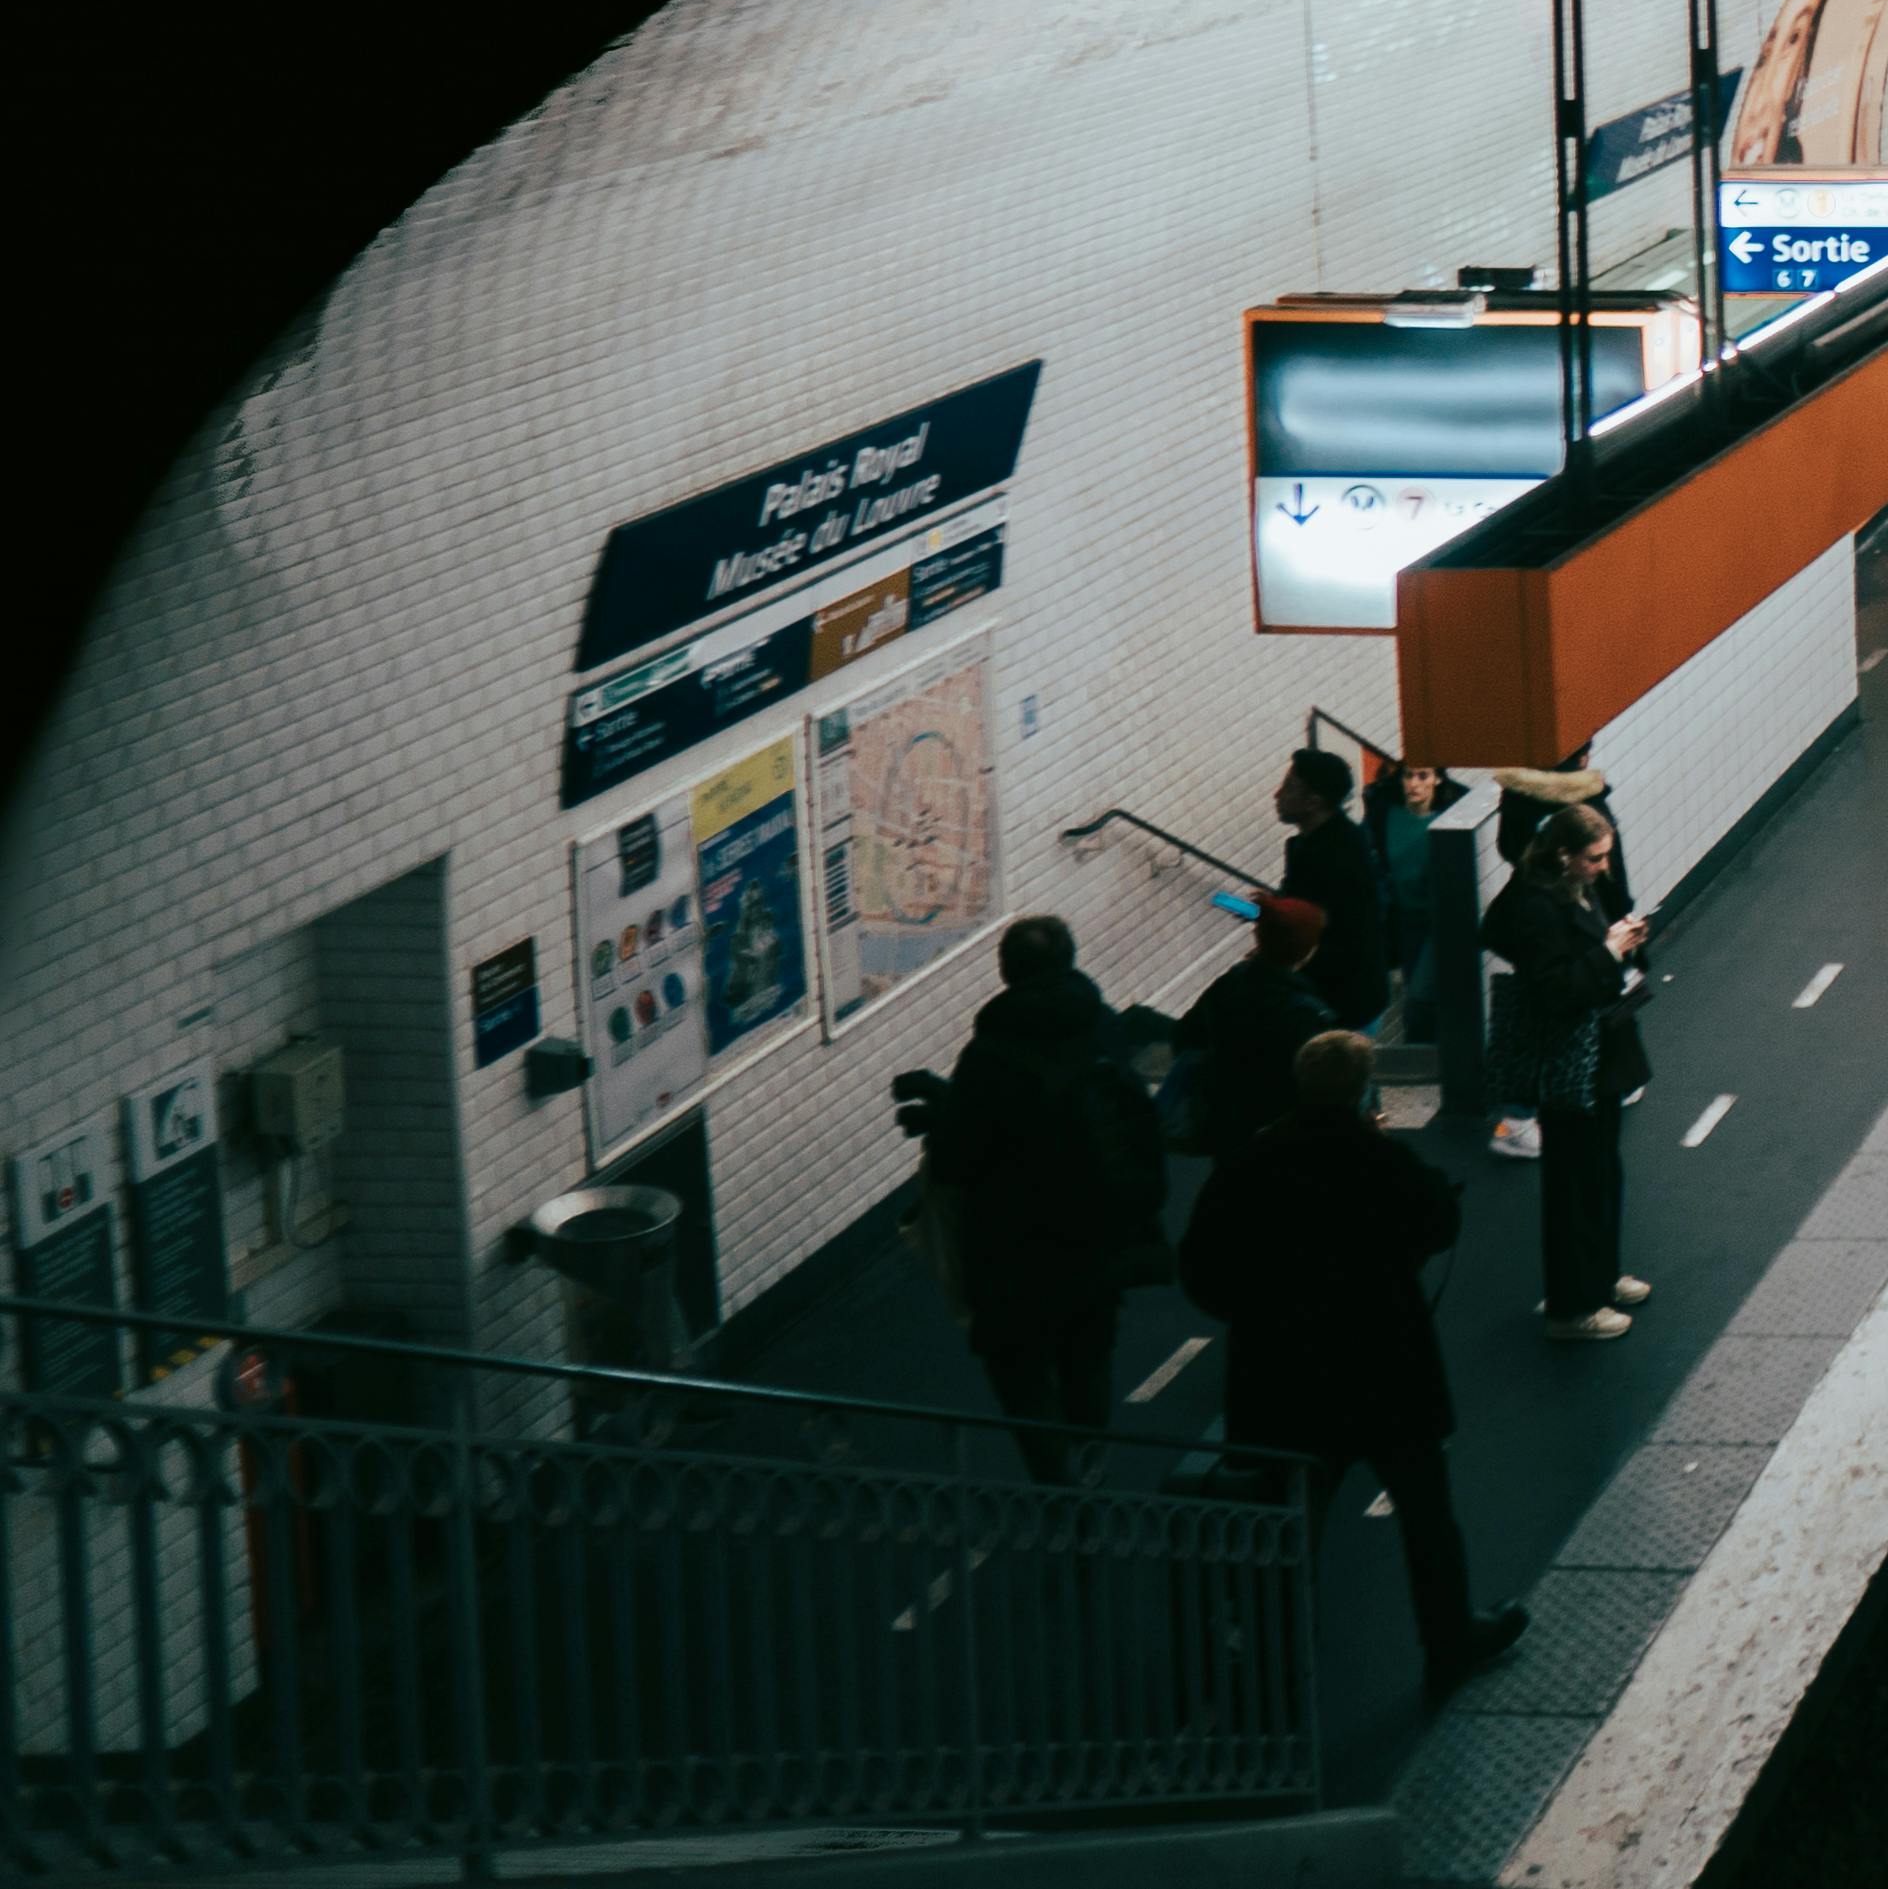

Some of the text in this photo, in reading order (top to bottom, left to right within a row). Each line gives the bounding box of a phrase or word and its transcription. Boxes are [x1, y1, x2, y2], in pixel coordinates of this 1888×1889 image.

[1772, 233, 1871, 263] Sortie
[1776, 271, 1818, 288] 6 7
[759, 420, 931, 528] Palais Royal
[706, 473, 942, 602] Musée du Louvre
